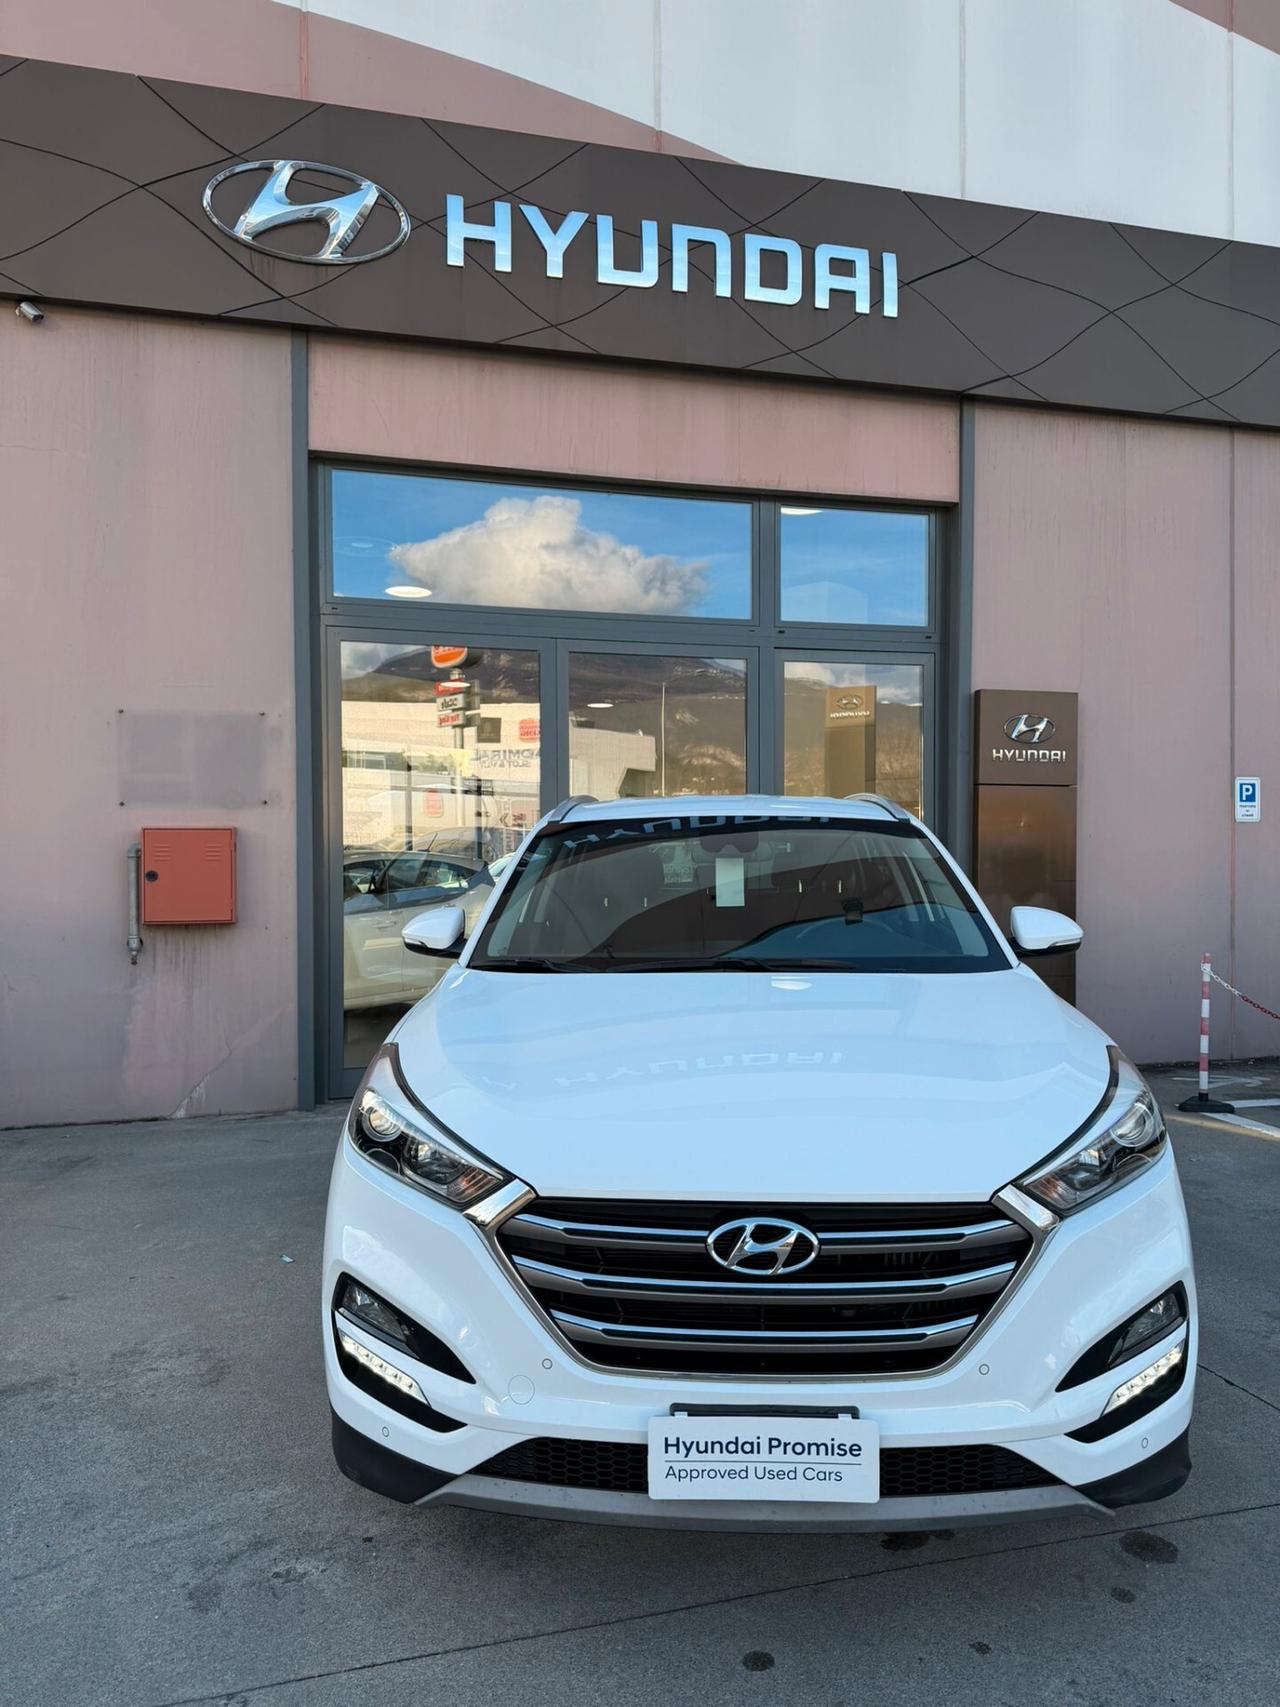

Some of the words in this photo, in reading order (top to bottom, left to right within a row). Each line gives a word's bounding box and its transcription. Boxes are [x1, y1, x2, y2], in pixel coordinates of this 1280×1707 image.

[446, 194, 899, 318] HYUNDAI
[992, 748, 1067, 763] HYUNDAI
[1242, 784, 1254, 801] P
[664, 1436, 761, 1458] Hyundai
[768, 1437, 862, 1457] Promise
[665, 1465, 749, 1482] Approved
[755, 1466, 797, 1480] Used
[803, 1467, 843, 1481] Cars
